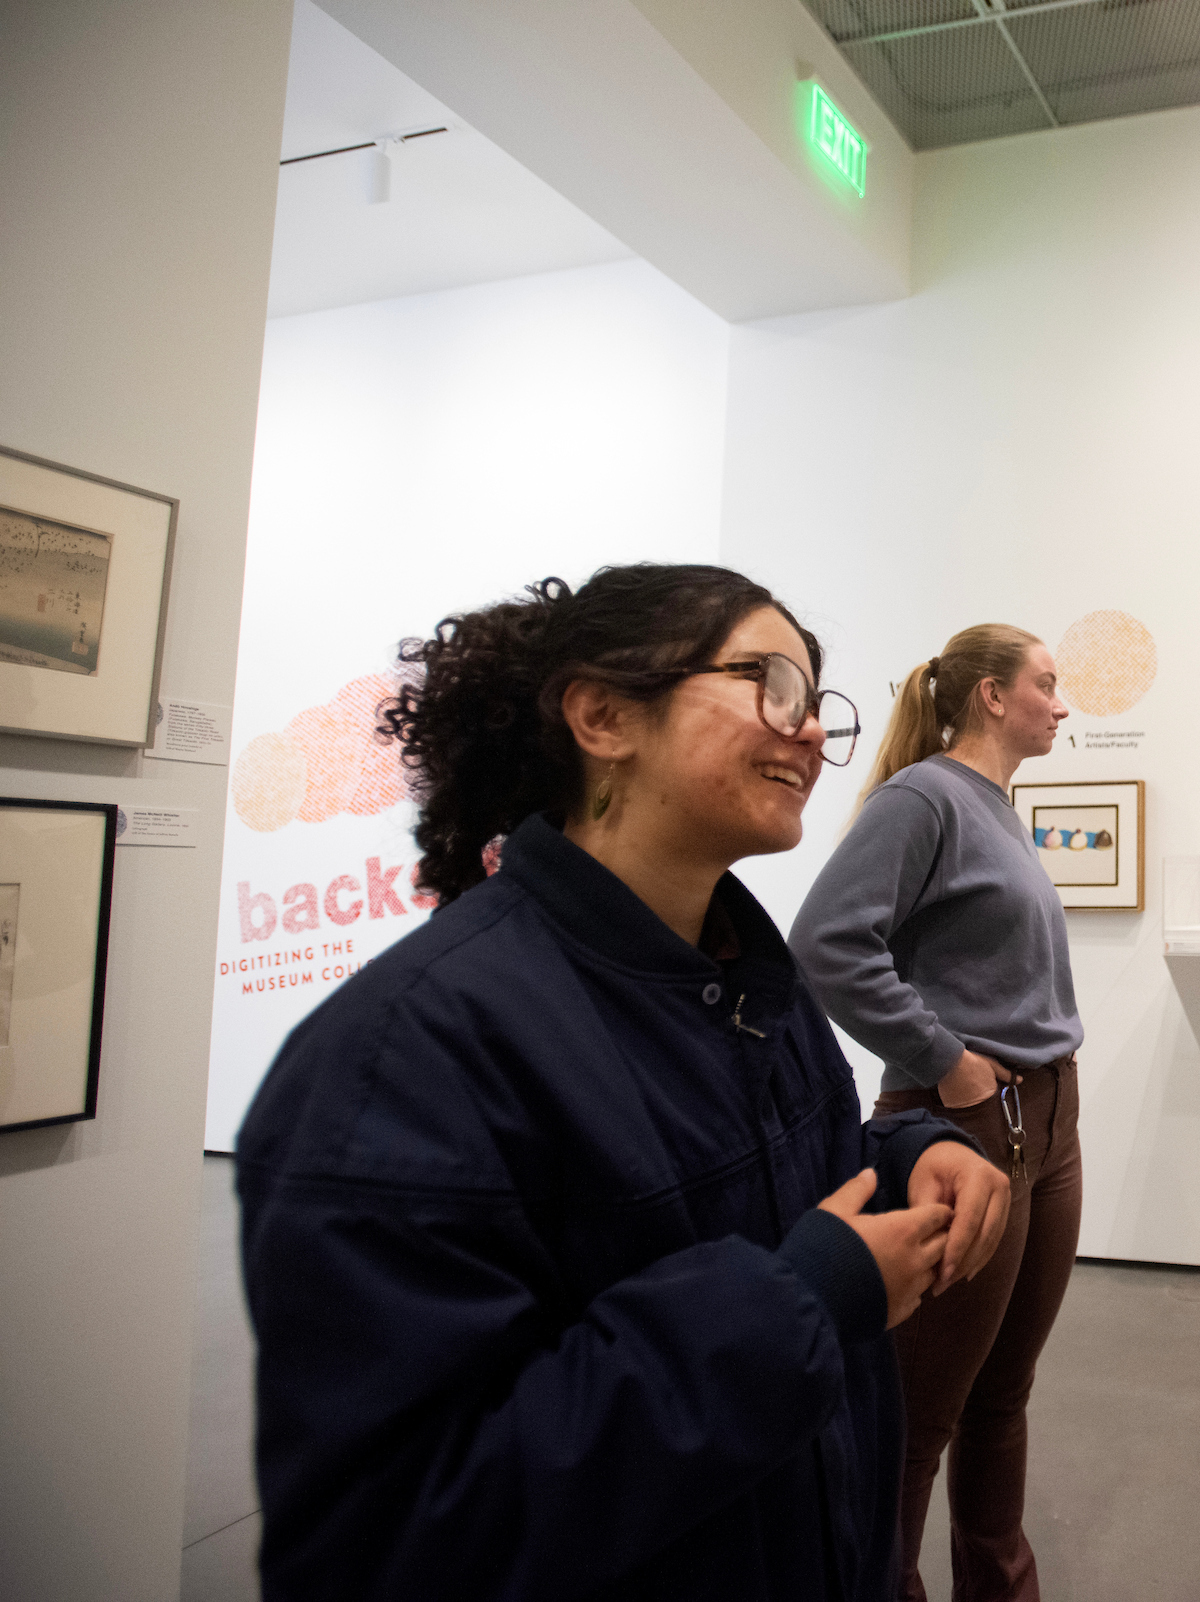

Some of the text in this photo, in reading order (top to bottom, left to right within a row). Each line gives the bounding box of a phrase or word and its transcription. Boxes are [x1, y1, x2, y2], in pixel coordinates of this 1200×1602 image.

[820, 98, 862, 184] EXIT
[1067, 733, 1076, 749] 1
[220, 939, 354, 976] DIGITIZING THE
[241, 971, 314, 995] MUSEUM
